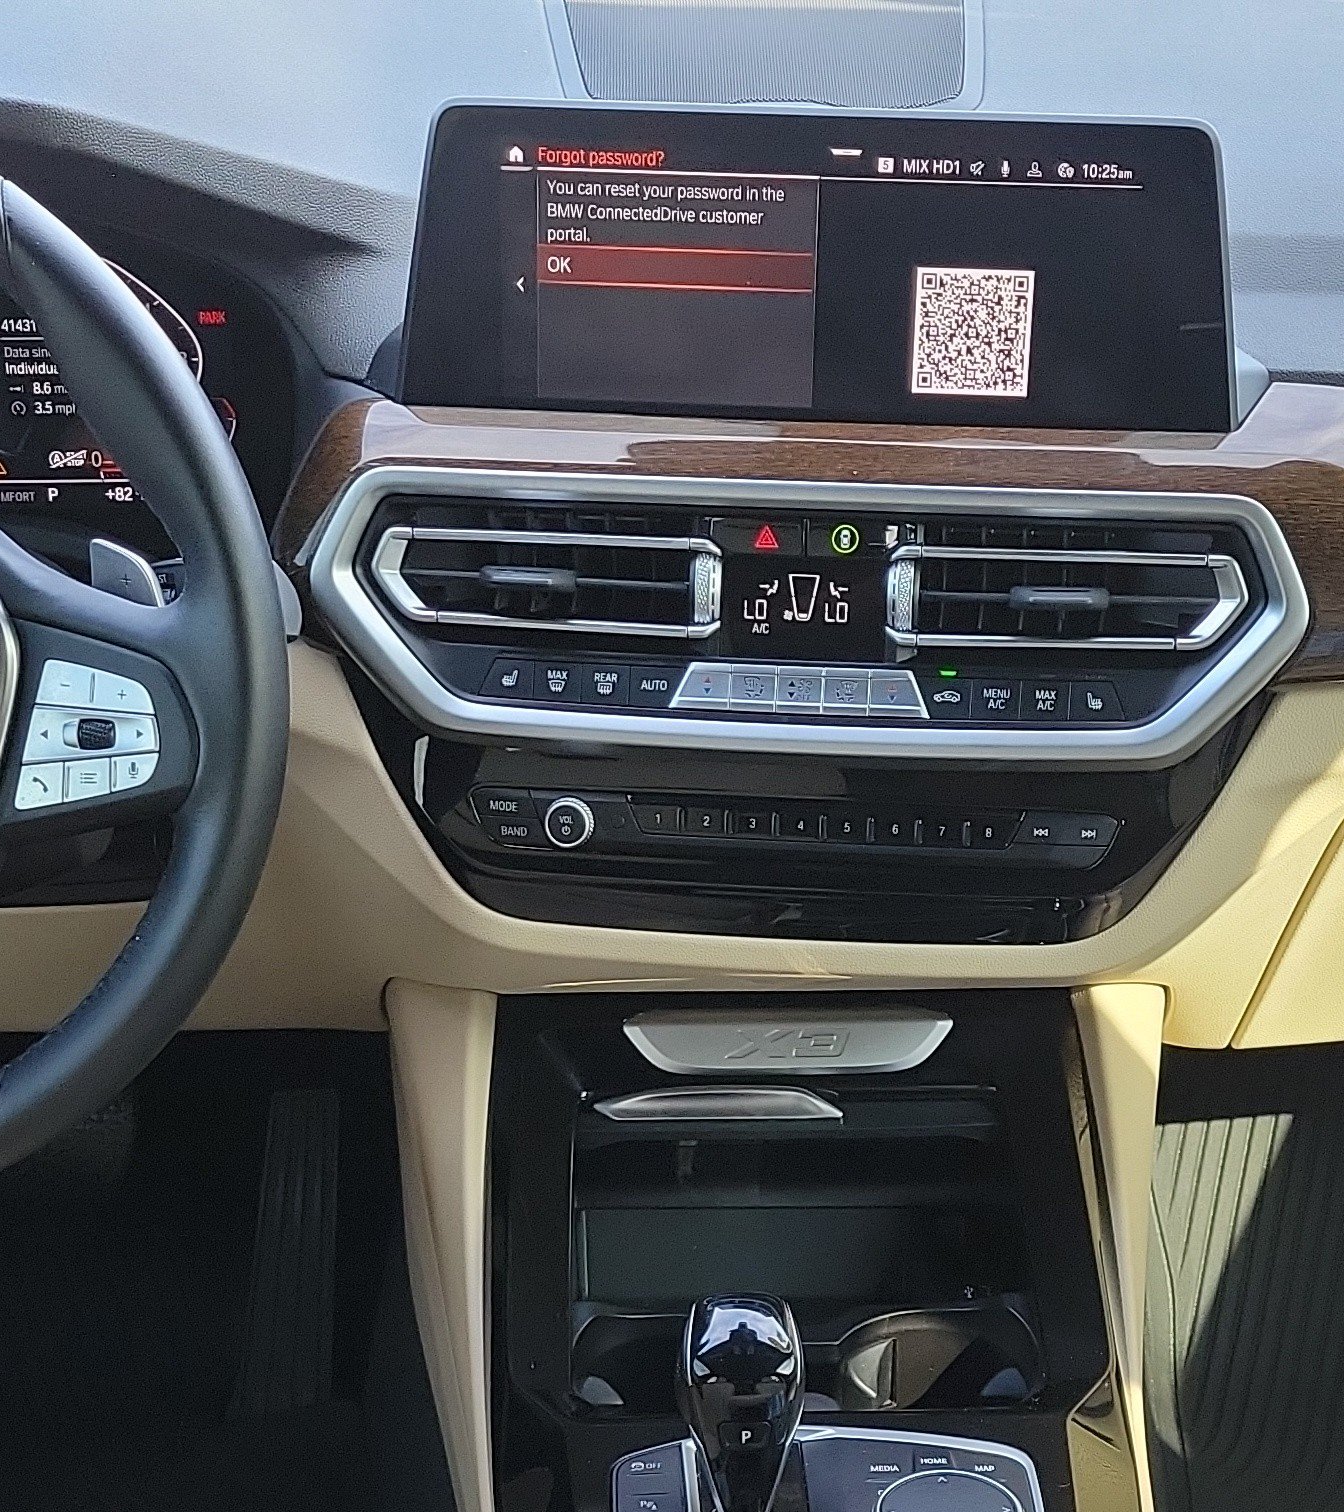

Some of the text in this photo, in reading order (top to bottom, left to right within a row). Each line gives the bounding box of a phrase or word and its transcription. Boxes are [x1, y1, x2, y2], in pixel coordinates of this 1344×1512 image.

[537, 147, 665, 168] Forgot password?
[881, 160, 891, 171] 5
[903, 159, 960, 175] MIX HD1
[1081, 164, 1133, 180] 10:25am
[547, 180, 785, 202] You can reset your password in the
[547, 203, 764, 225] BMW ConnectedDrive customer
[547, 227, 591, 244] portal.
[547, 256, 572, 274] OK
[199, 311, 226, 324] PARK
[3, 346, 30, 358] Data
[32, 381, 52, 395] 8.6
[34, 401, 53, 414] 3.5
[48, 487, 59, 502] P
[104, 487, 133, 502] +82
[743, 599, 767, 620] LO
[824, 602, 849, 623] LO
[752, 622, 770, 635] A/C
[547, 669, 568, 681] MAX
[594, 672, 618, 684] REAR
[640, 680, 668, 691] AUTO
[983, 687, 1011, 699] MENU
[1035, 689, 1057, 700] MAX
[987, 699, 1006, 710] A/C
[1037, 700, 1055, 711] A/C
[489, 800, 519, 813] MODE
[558, 815, 574, 825] VOL
[654, 813, 661, 825] 1
[702, 815, 710, 827] 2
[749, 817, 756, 829] 3
[500, 825, 528, 837] BAND
[797, 820, 804, 831] 4
[843, 821, 851, 833] 5
[892, 824, 899, 835] 6
[939, 826, 946, 837] 7
[985, 827, 992, 838] 8
[724, 1027, 850, 1059] X3
[741, 1430, 752, 1443] P
[920, 1457, 948, 1465] HOME
[870, 1464, 899, 1473] MEDIA
